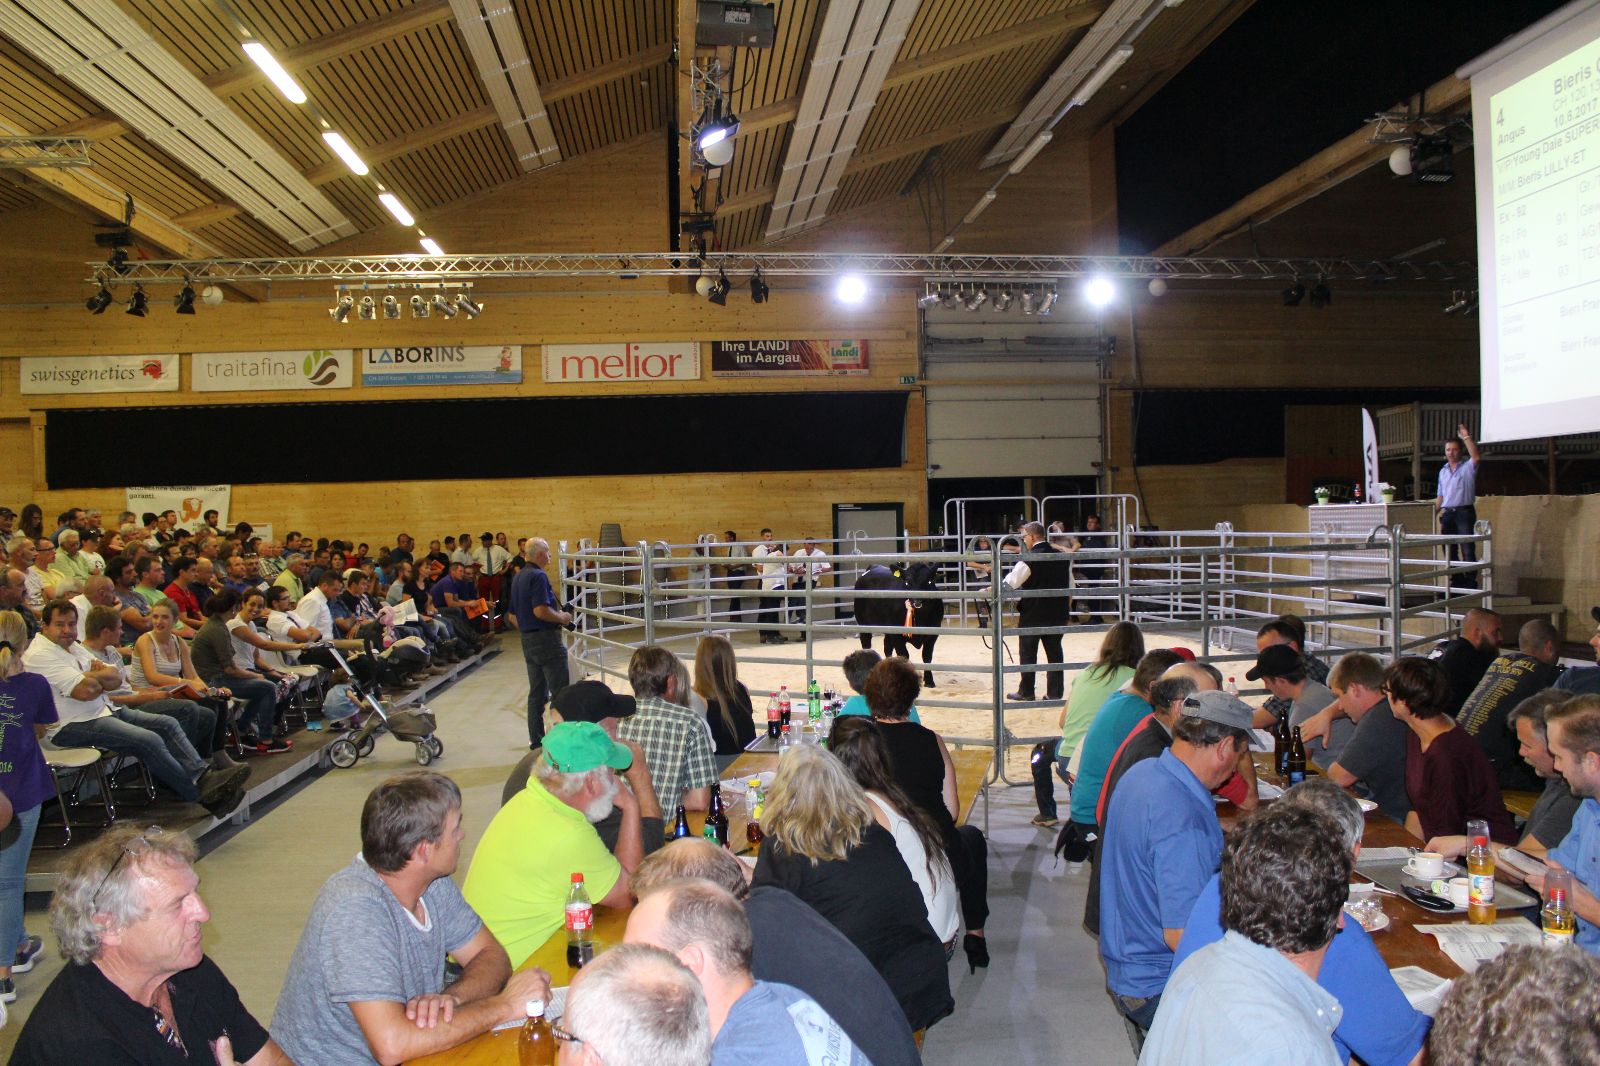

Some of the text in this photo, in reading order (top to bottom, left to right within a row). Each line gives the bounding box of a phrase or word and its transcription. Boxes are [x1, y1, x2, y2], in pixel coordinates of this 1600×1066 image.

[1554, 65, 1592, 95] Bieris
[1496, 107, 1505, 127] 4
[1497, 126, 1526, 146] Angus
[1513, 147, 1541, 167] Young
[1542, 137, 1562, 154] Dale
[368, 346, 465, 364] LABORINS
[721, 340, 790, 352] Ihre LANDI
[832, 347, 858, 357] Landi
[207, 357, 297, 378] traitafina
[561, 343, 682, 379] melior
[736, 352, 800, 365] im Aargau
[30, 365, 136, 386] swissgenetics
